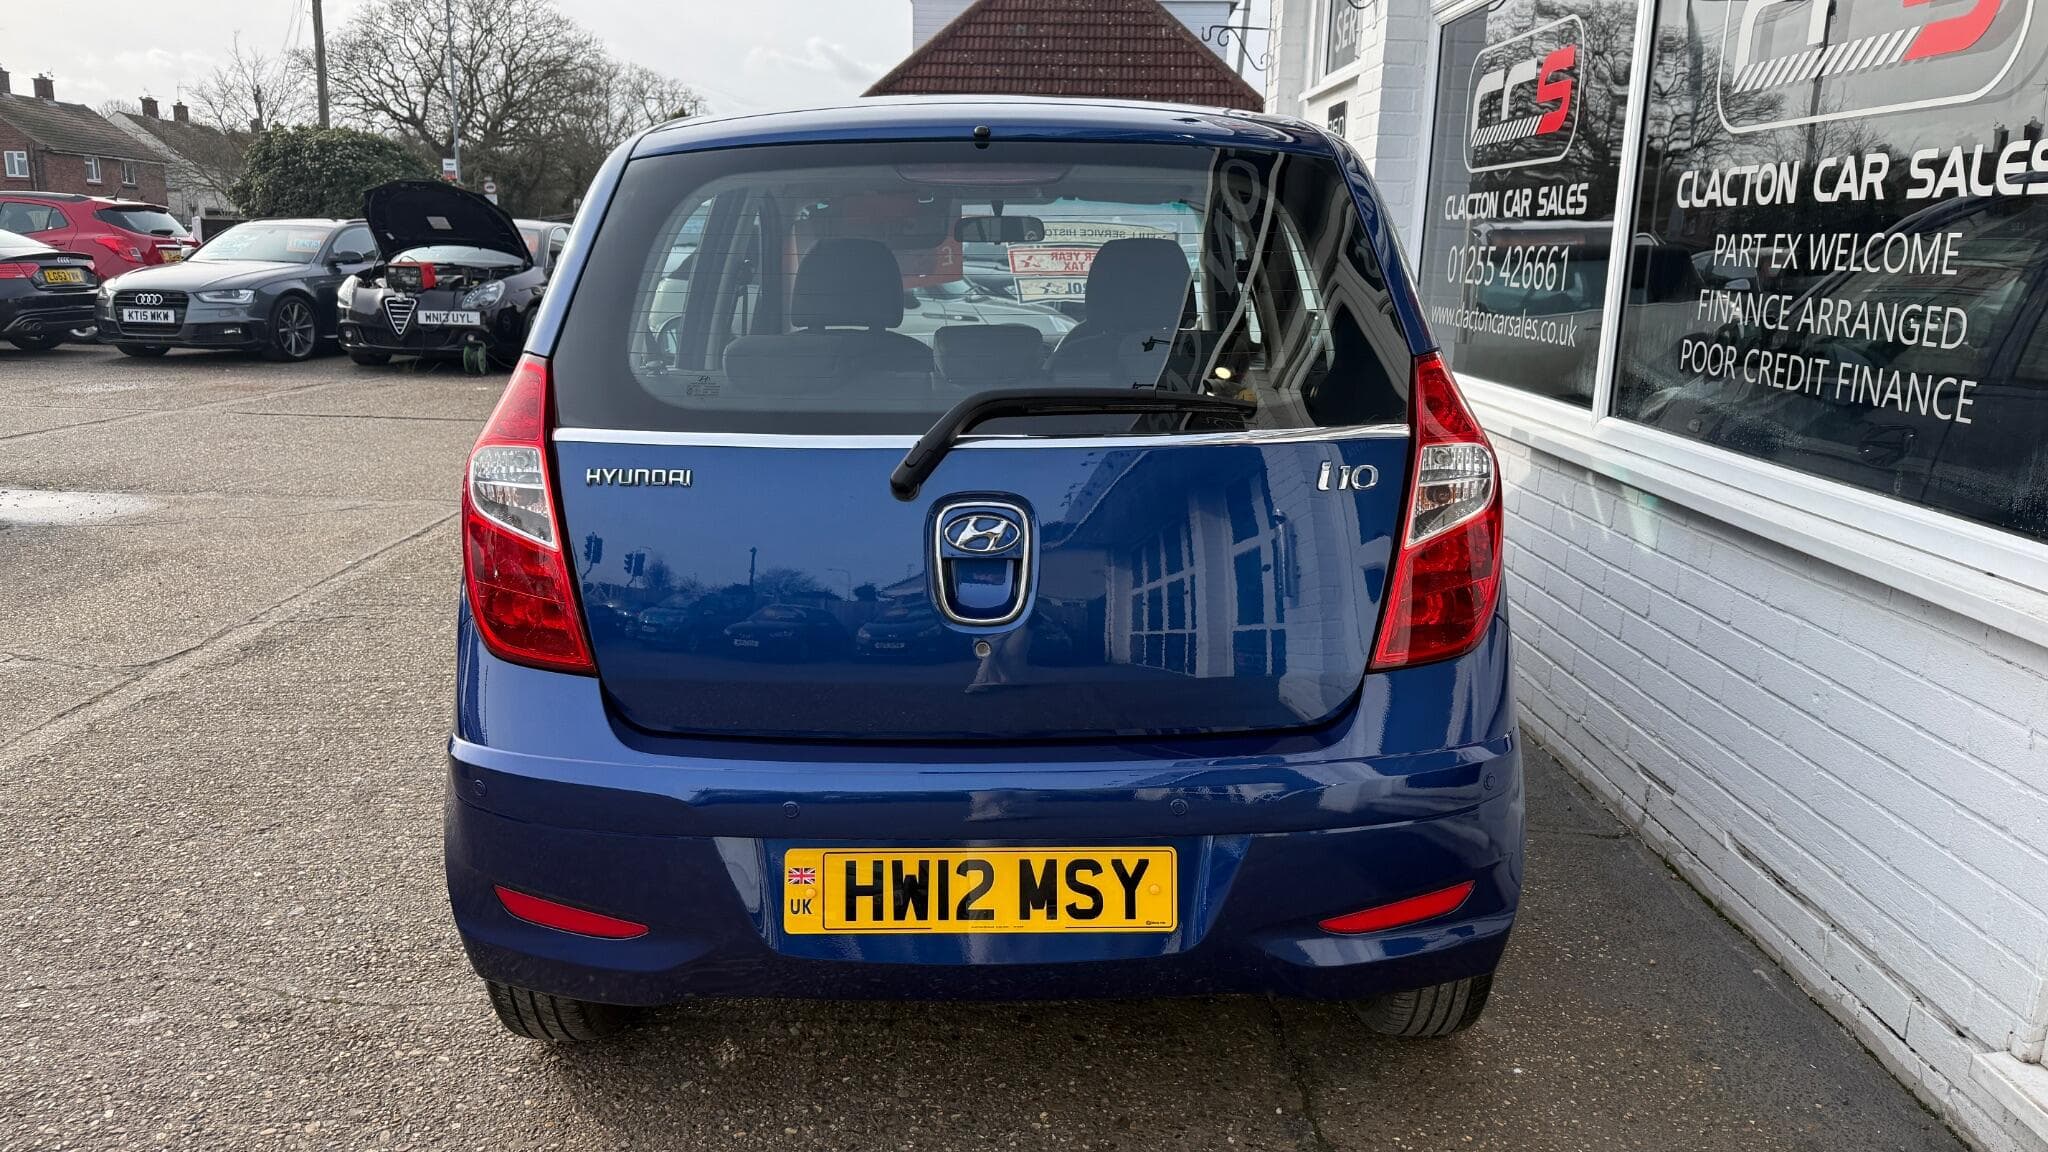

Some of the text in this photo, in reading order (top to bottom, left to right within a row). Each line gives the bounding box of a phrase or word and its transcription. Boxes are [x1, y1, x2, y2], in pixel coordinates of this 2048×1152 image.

[1445, 183, 1589, 220] CLACTON CAR SALES
[1676, 160, 1801, 209] CLACTON
[1813, 152, 1890, 203] CAR
[1447, 245, 1570, 291] 01255 426661
[1713, 232, 1963, 276] PART EX WELCOME
[452, 312, 474, 324] UYL
[1431, 302, 1577, 348] www.clactoncarsales.co.uk
[1697, 289, 1968, 350] FINANCE ARRANGED
[1680, 338, 1978, 424] POOR CREDIT FINANCE
[586, 468, 692, 487] HYUNDAI
[790, 898, 813, 916] UK
[845, 858, 1150, 922] HW12 MSY
